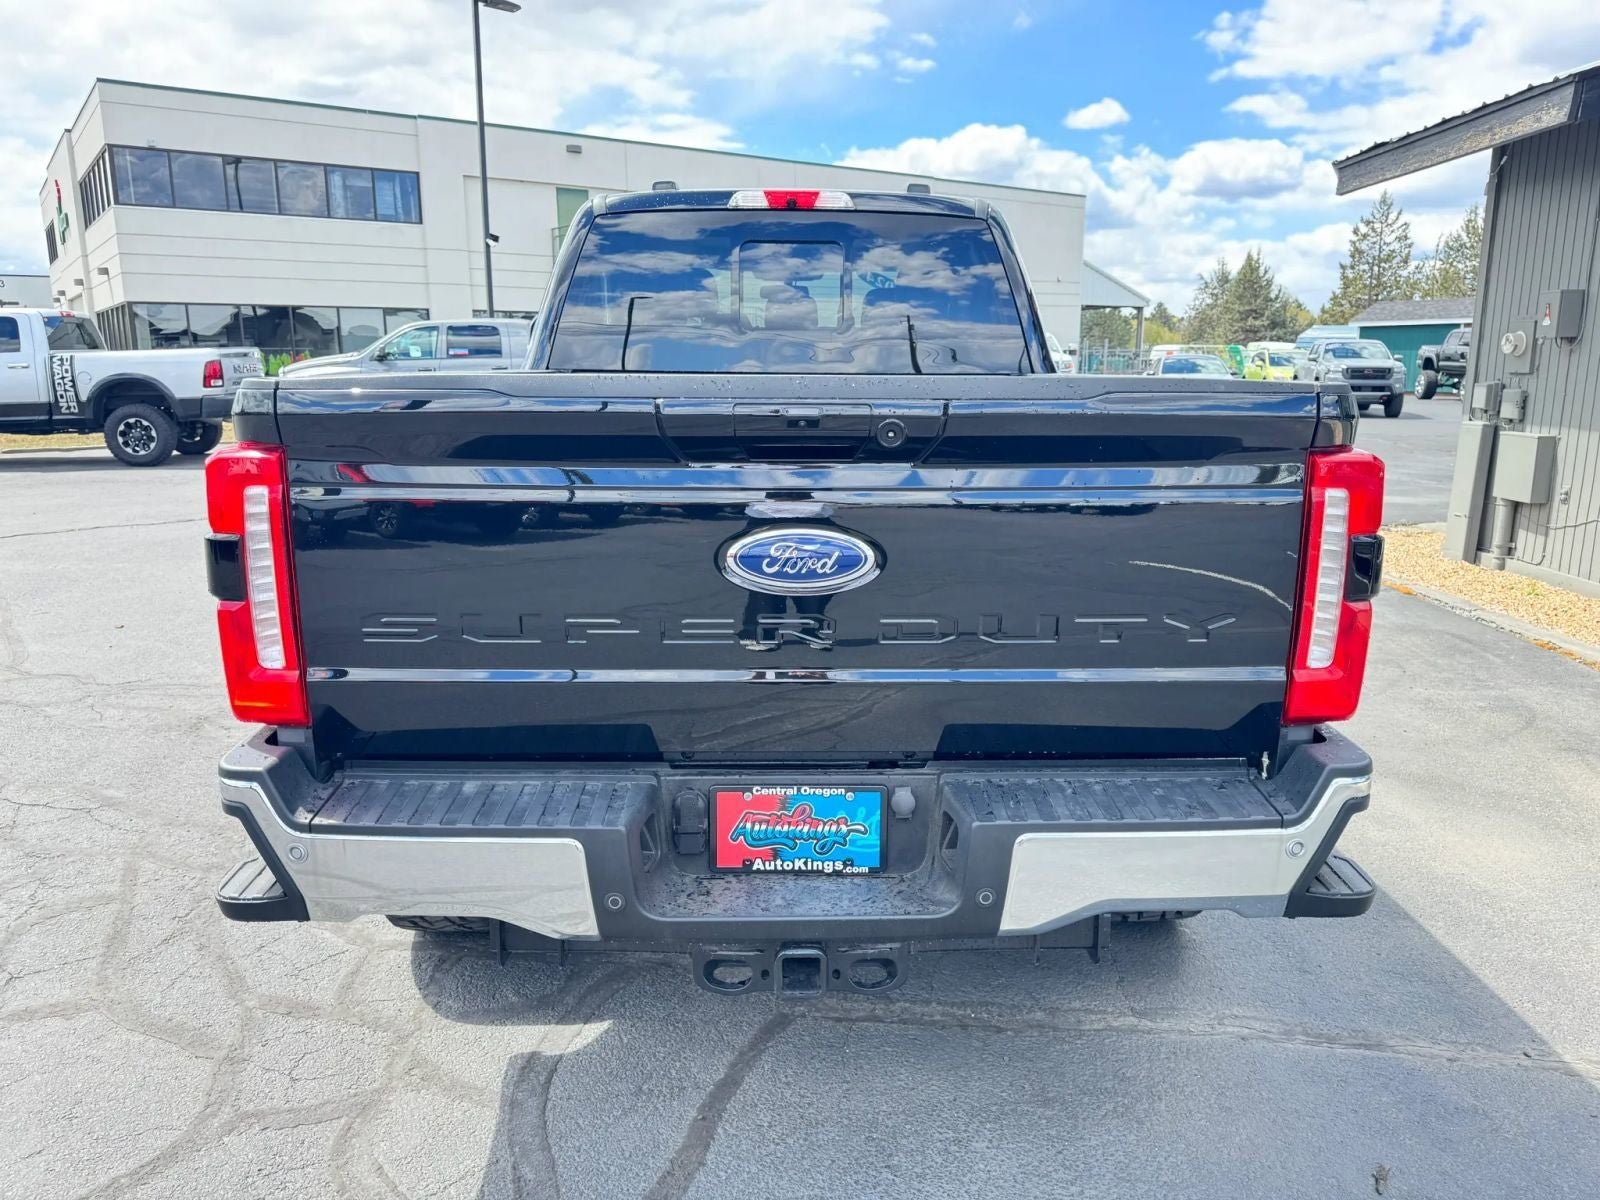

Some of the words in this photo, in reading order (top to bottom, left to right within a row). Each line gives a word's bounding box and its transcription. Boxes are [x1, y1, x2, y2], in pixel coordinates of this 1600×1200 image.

[52, 355, 71, 414] WAGON
[62, 354, 79, 413] POWER
[762, 542, 842, 574] Ford
[361, 612, 837, 646] SUPER
[878, 612, 1237, 645] DUTY
[752, 786, 798, 796] Central
[800, 786, 846, 797] Oregon
[752, 858, 869, 874] AutoKings.com
